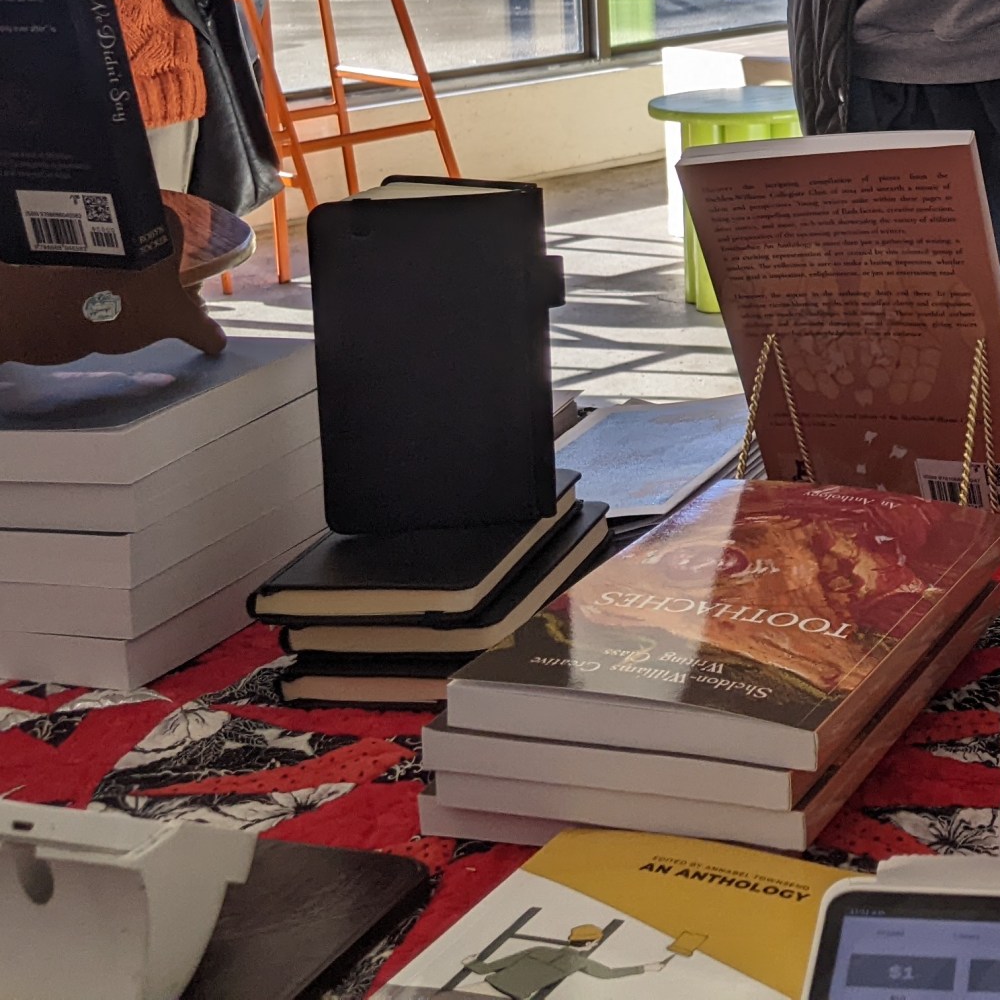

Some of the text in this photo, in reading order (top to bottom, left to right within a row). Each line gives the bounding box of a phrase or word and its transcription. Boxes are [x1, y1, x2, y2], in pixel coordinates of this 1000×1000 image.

[110, 88, 131, 122] Say
[803, 490, 902, 509] An Anthology
[597, 590, 852, 640] TOOTHACHES
[530, 654, 773, 700] Sheldon-Williams Creative
[602, 646, 724, 674] Writing Class
[639, 862, 811, 902] AN ANTHOLOGY
[652, 855, 688, 866] EDITED
[705, 865, 750, 879] ANNABEL
[754, 874, 811, 891] TOWNSEND
[888, 963, 915, 981] $1
